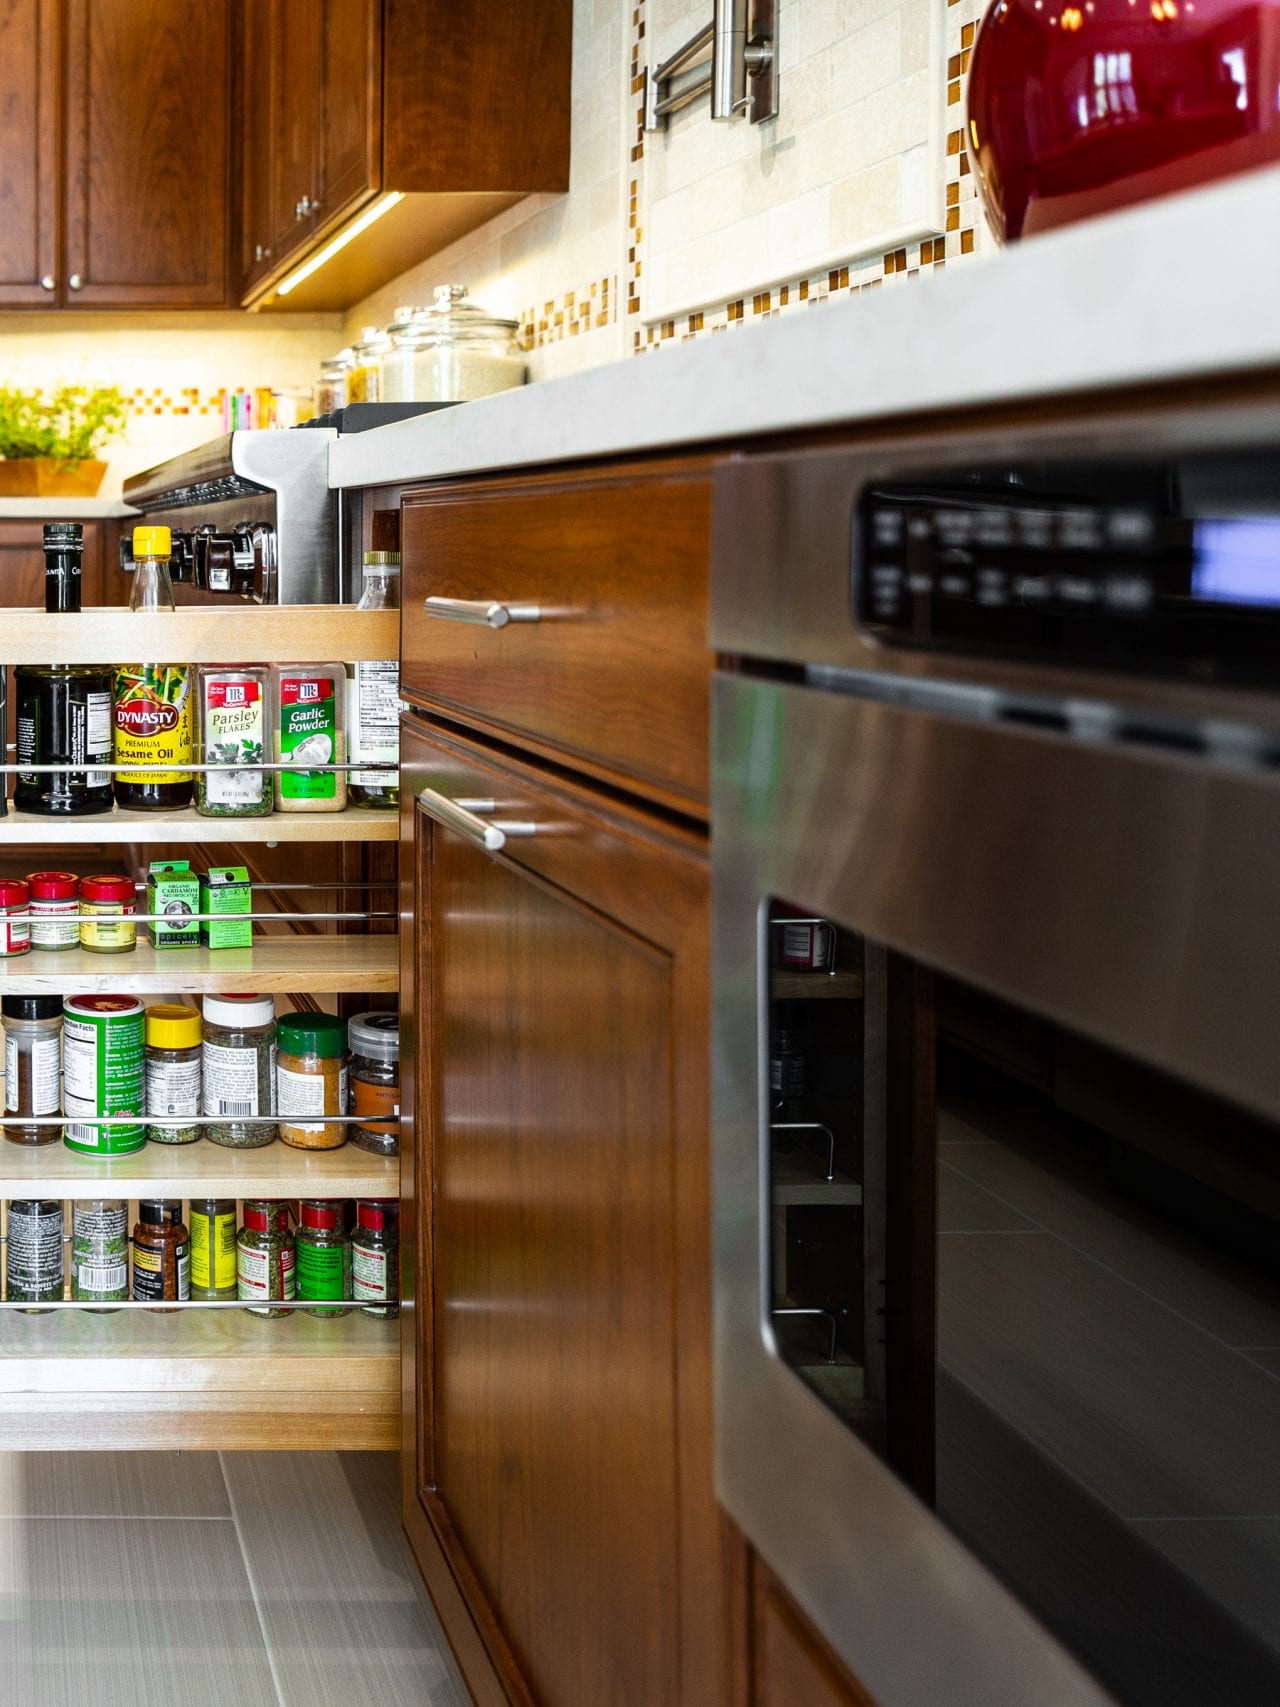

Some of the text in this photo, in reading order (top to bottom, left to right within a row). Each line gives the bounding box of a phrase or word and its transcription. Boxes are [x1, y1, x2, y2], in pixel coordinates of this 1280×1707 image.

[117, 711, 174, 724] DYNASTY
[213, 710, 259, 726] Parsley
[291, 708, 325, 722] Garlic
[218, 722, 251, 734] FLAKES
[288, 718, 330, 733] Powder
[125, 740, 160, 748] PREMIUM
[116, 748, 174, 759] Sesame Oil
[79, 1024, 95, 1032] Facts
